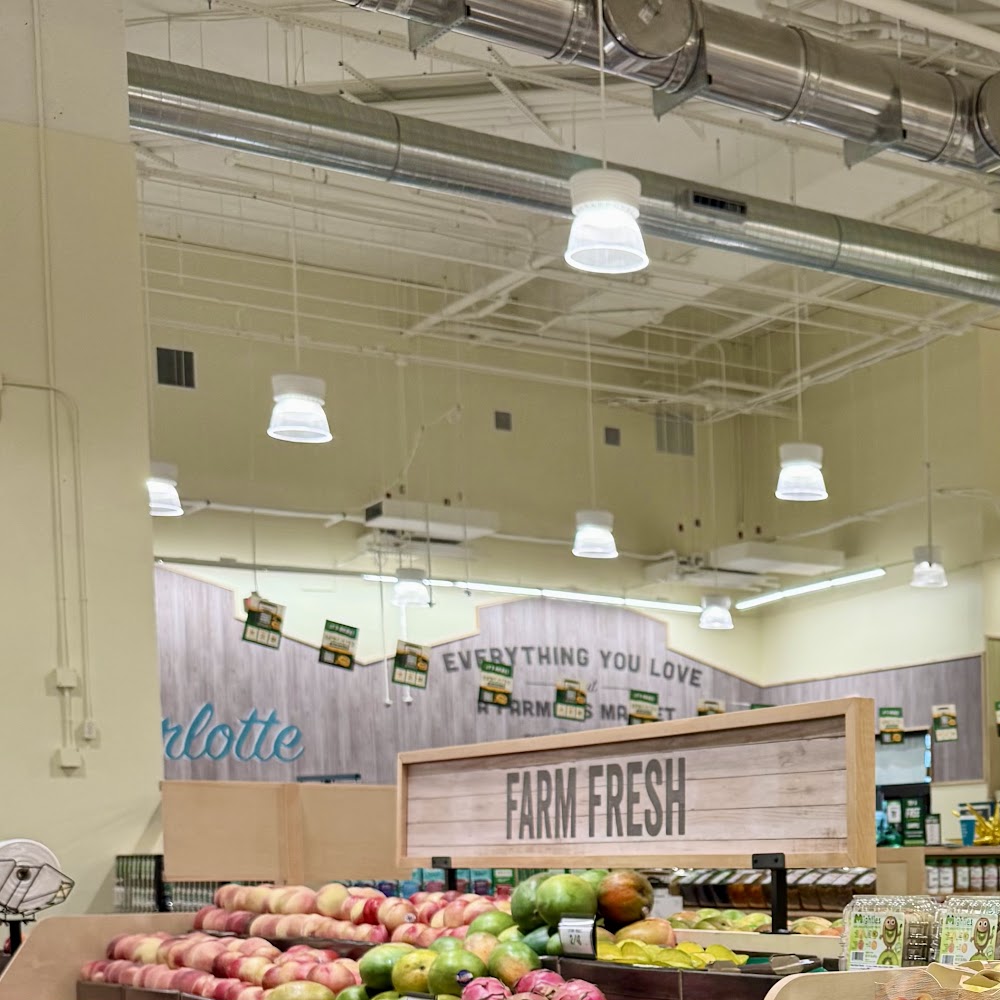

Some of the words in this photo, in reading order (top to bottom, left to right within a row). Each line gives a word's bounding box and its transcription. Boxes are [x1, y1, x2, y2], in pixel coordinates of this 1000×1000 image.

[441, 645, 590, 673] EVERYTHING
[600, 649, 641, 673] YOU
[649, 658, 703, 688] LOVE
[506, 767, 576, 839] FARM
[589, 757, 686, 838] FRESH
